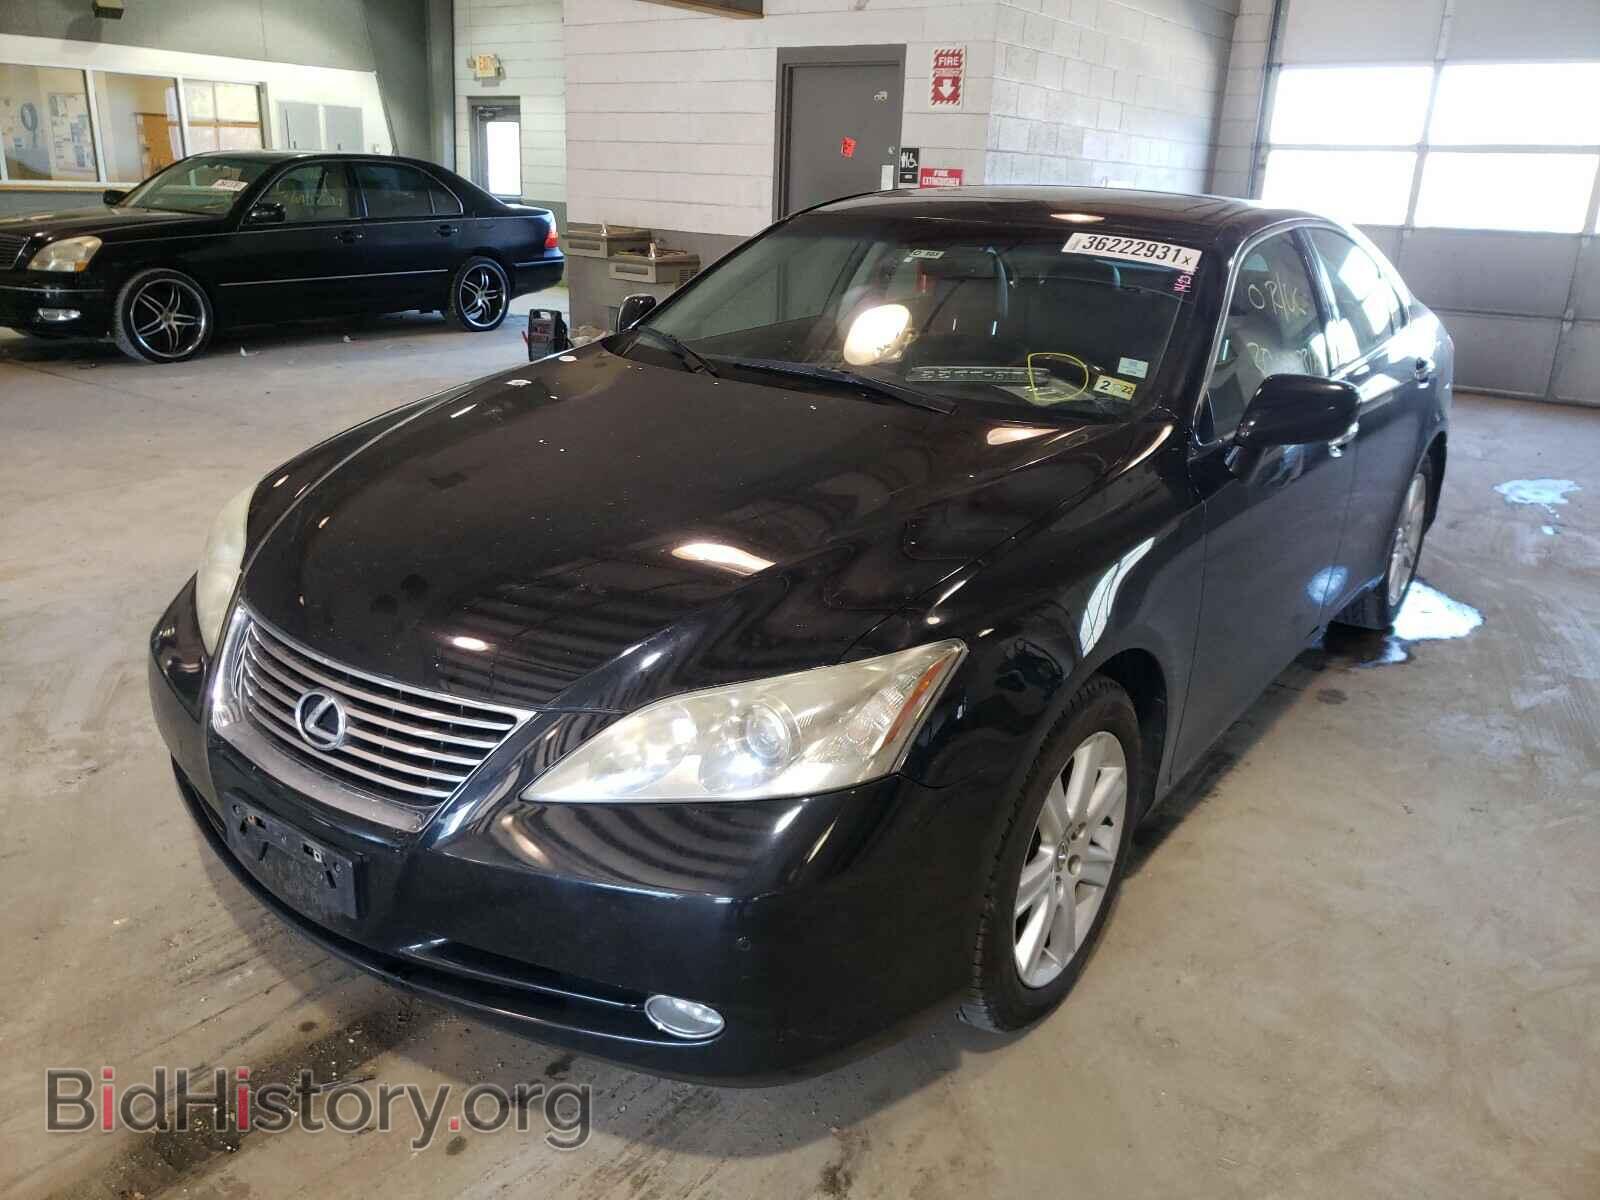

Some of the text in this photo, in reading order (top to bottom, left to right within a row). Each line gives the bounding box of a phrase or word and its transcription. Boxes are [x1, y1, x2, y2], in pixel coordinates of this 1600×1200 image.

[938, 56, 960, 66] FIRE
[1082, 236, 1182, 263] 36222931
[1099, 380, 1112, 391] 2
